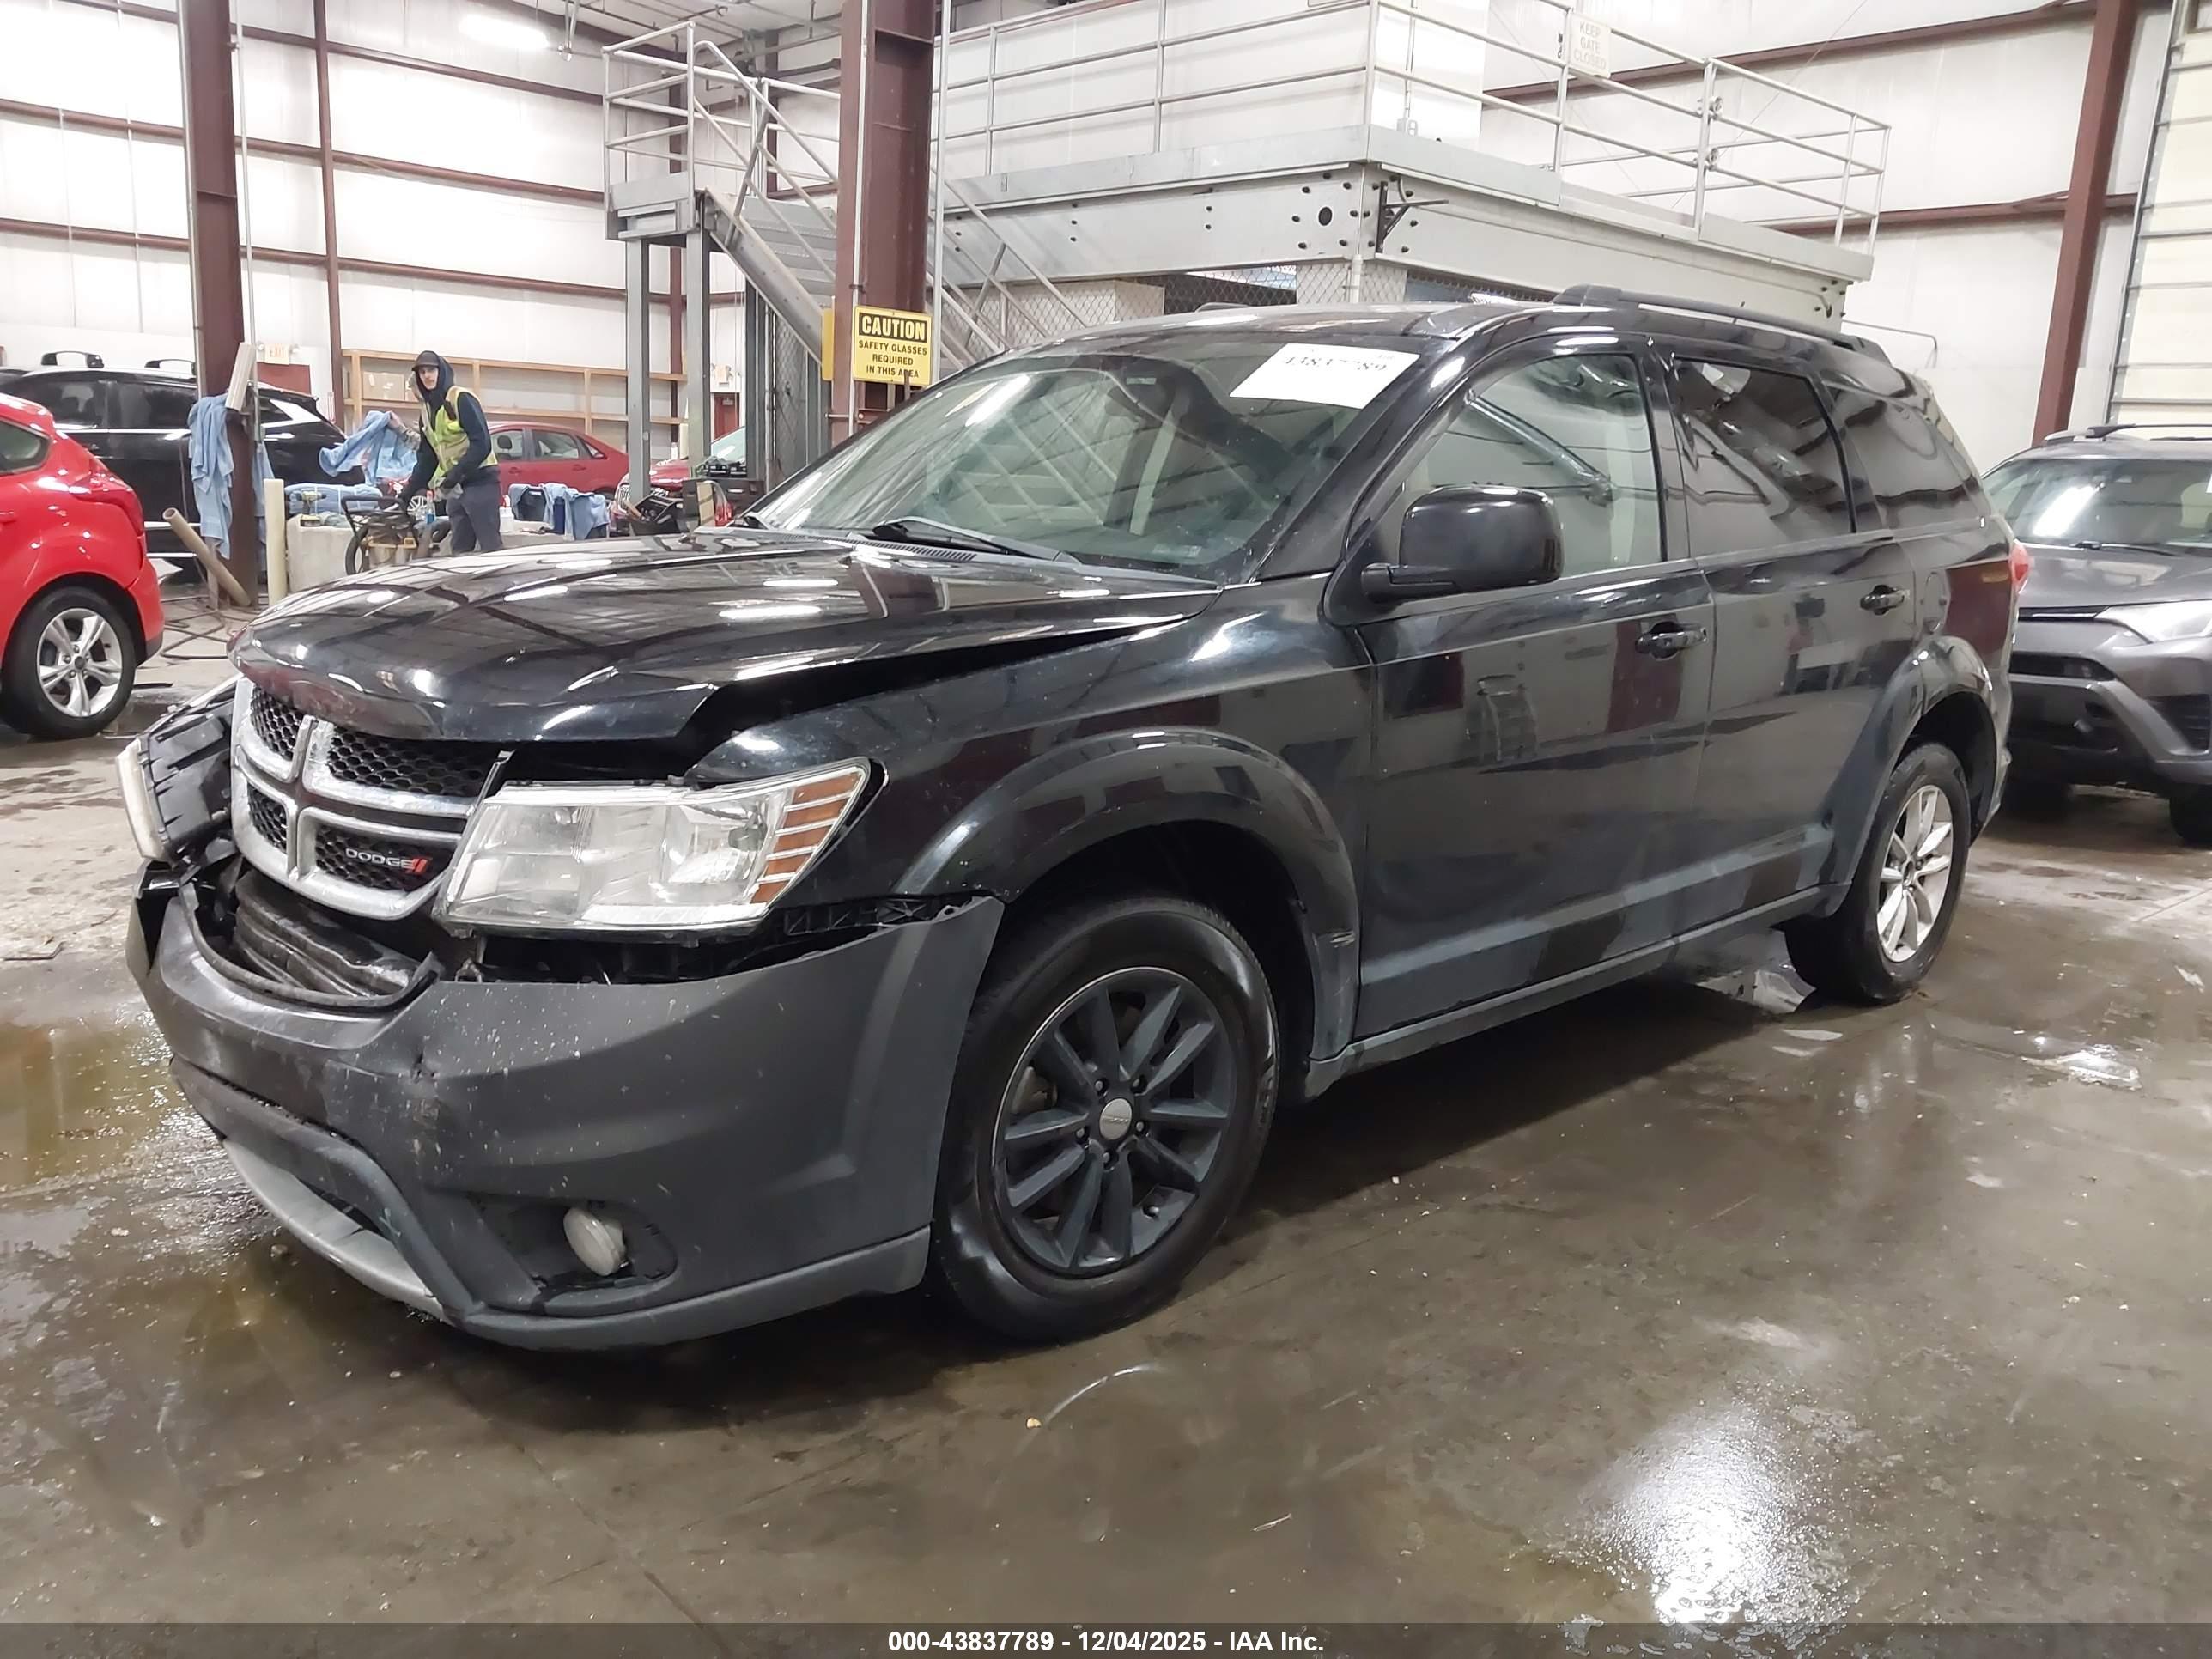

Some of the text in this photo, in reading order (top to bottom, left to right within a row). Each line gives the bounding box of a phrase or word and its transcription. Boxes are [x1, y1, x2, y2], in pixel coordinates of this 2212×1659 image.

[1579, 21, 1601, 38] KEEP
[1580, 36, 1601, 54] GATE
[1573, 48, 1607, 69] CLOSED
[861, 315, 926, 341] CAUTION
[859, 340, 927, 356] SAFETY GLASSES
[872, 354, 914, 365] REQUIRED
[866, 365, 875, 374] IN
[878, 366, 896, 376] THIS
[345, 848, 416, 870] DODGE
